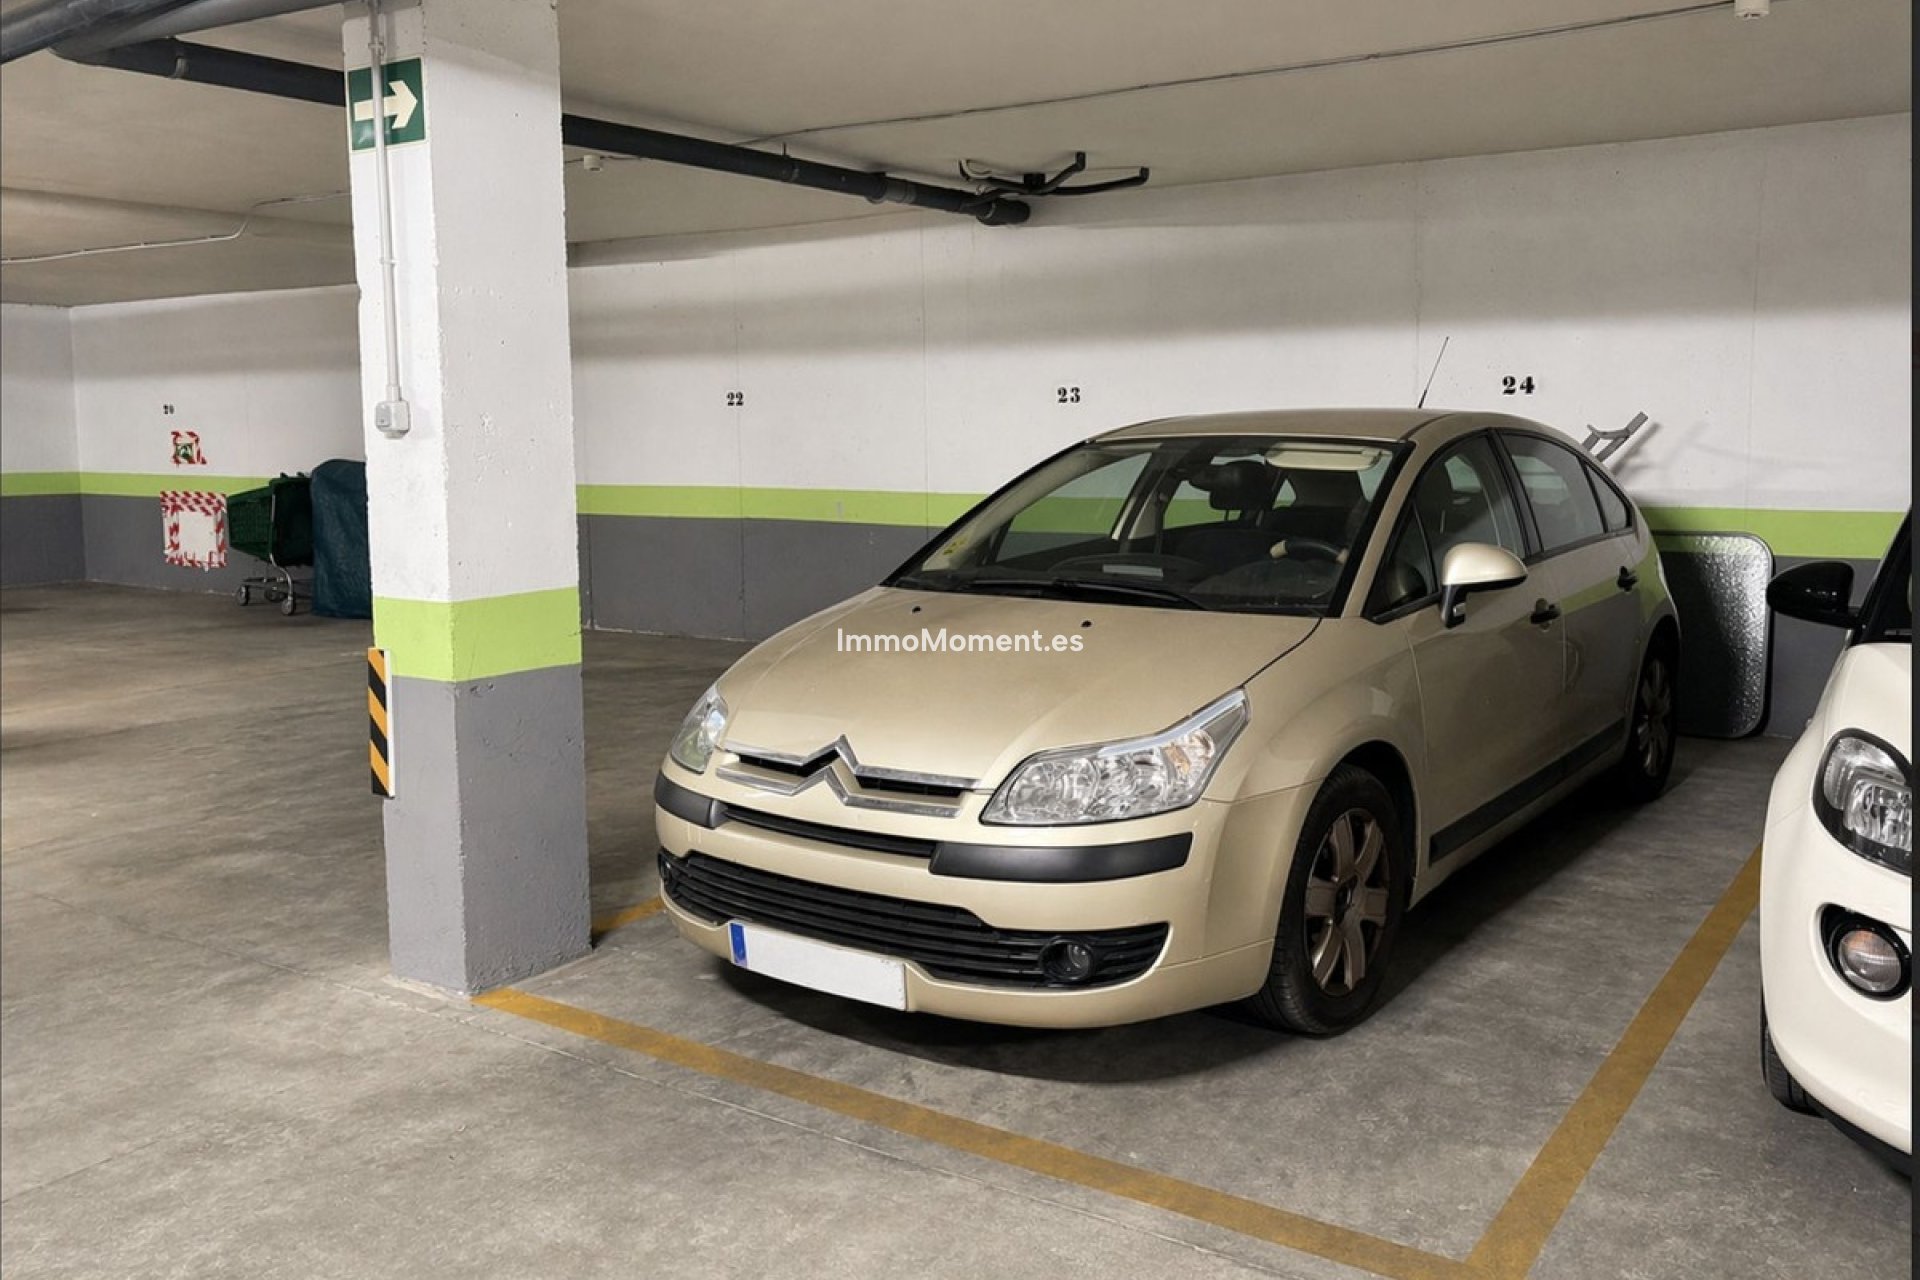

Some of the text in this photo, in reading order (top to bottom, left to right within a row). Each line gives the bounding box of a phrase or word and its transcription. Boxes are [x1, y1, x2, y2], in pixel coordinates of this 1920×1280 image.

[1502, 375, 1535, 395] 24
[726, 391, 744, 407] 22
[1057, 387, 1081, 404] 23
